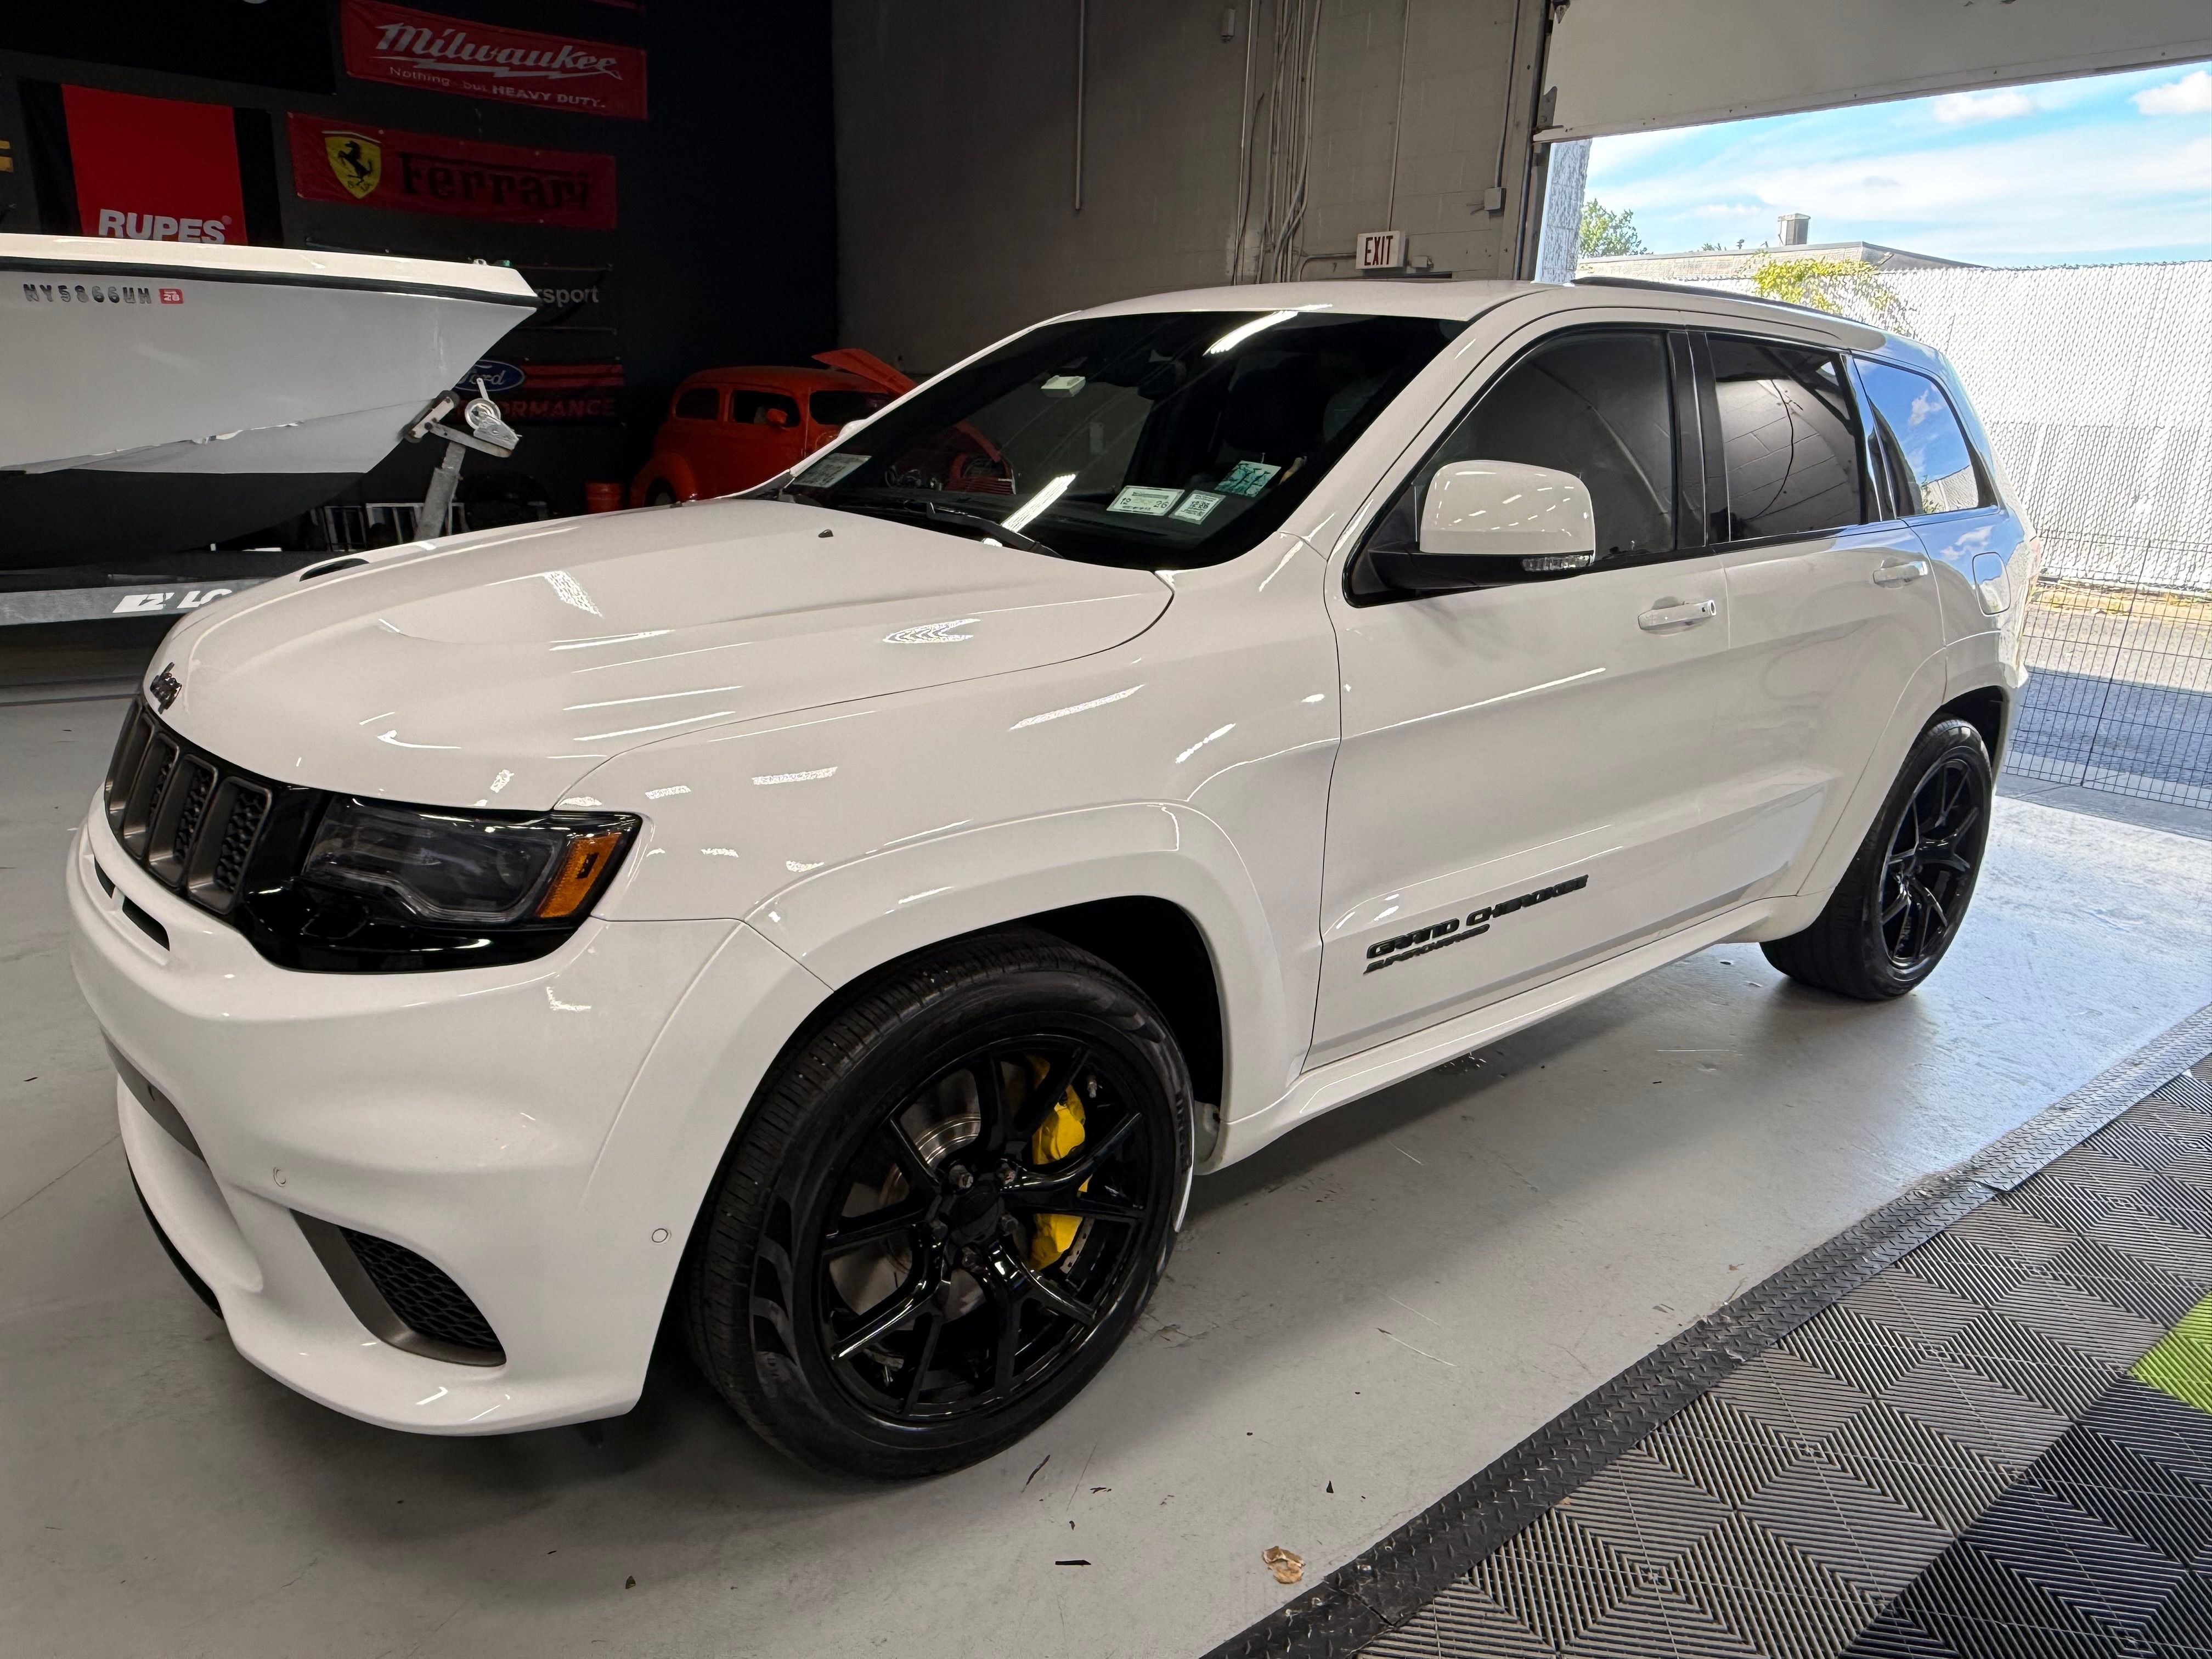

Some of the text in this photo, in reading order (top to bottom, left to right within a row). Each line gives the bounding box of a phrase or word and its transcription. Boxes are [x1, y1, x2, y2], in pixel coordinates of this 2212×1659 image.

[376, 22, 623, 80] Milwaukee
[390, 66, 450, 87] Nothing
[492, 84, 551, 101] HEAVY
[557, 94, 607, 108] DUTY.
[396, 151, 590, 210] Ferrari
[99, 208, 225, 245] RUPES
[1364, 235, 1393, 266] EXIT
